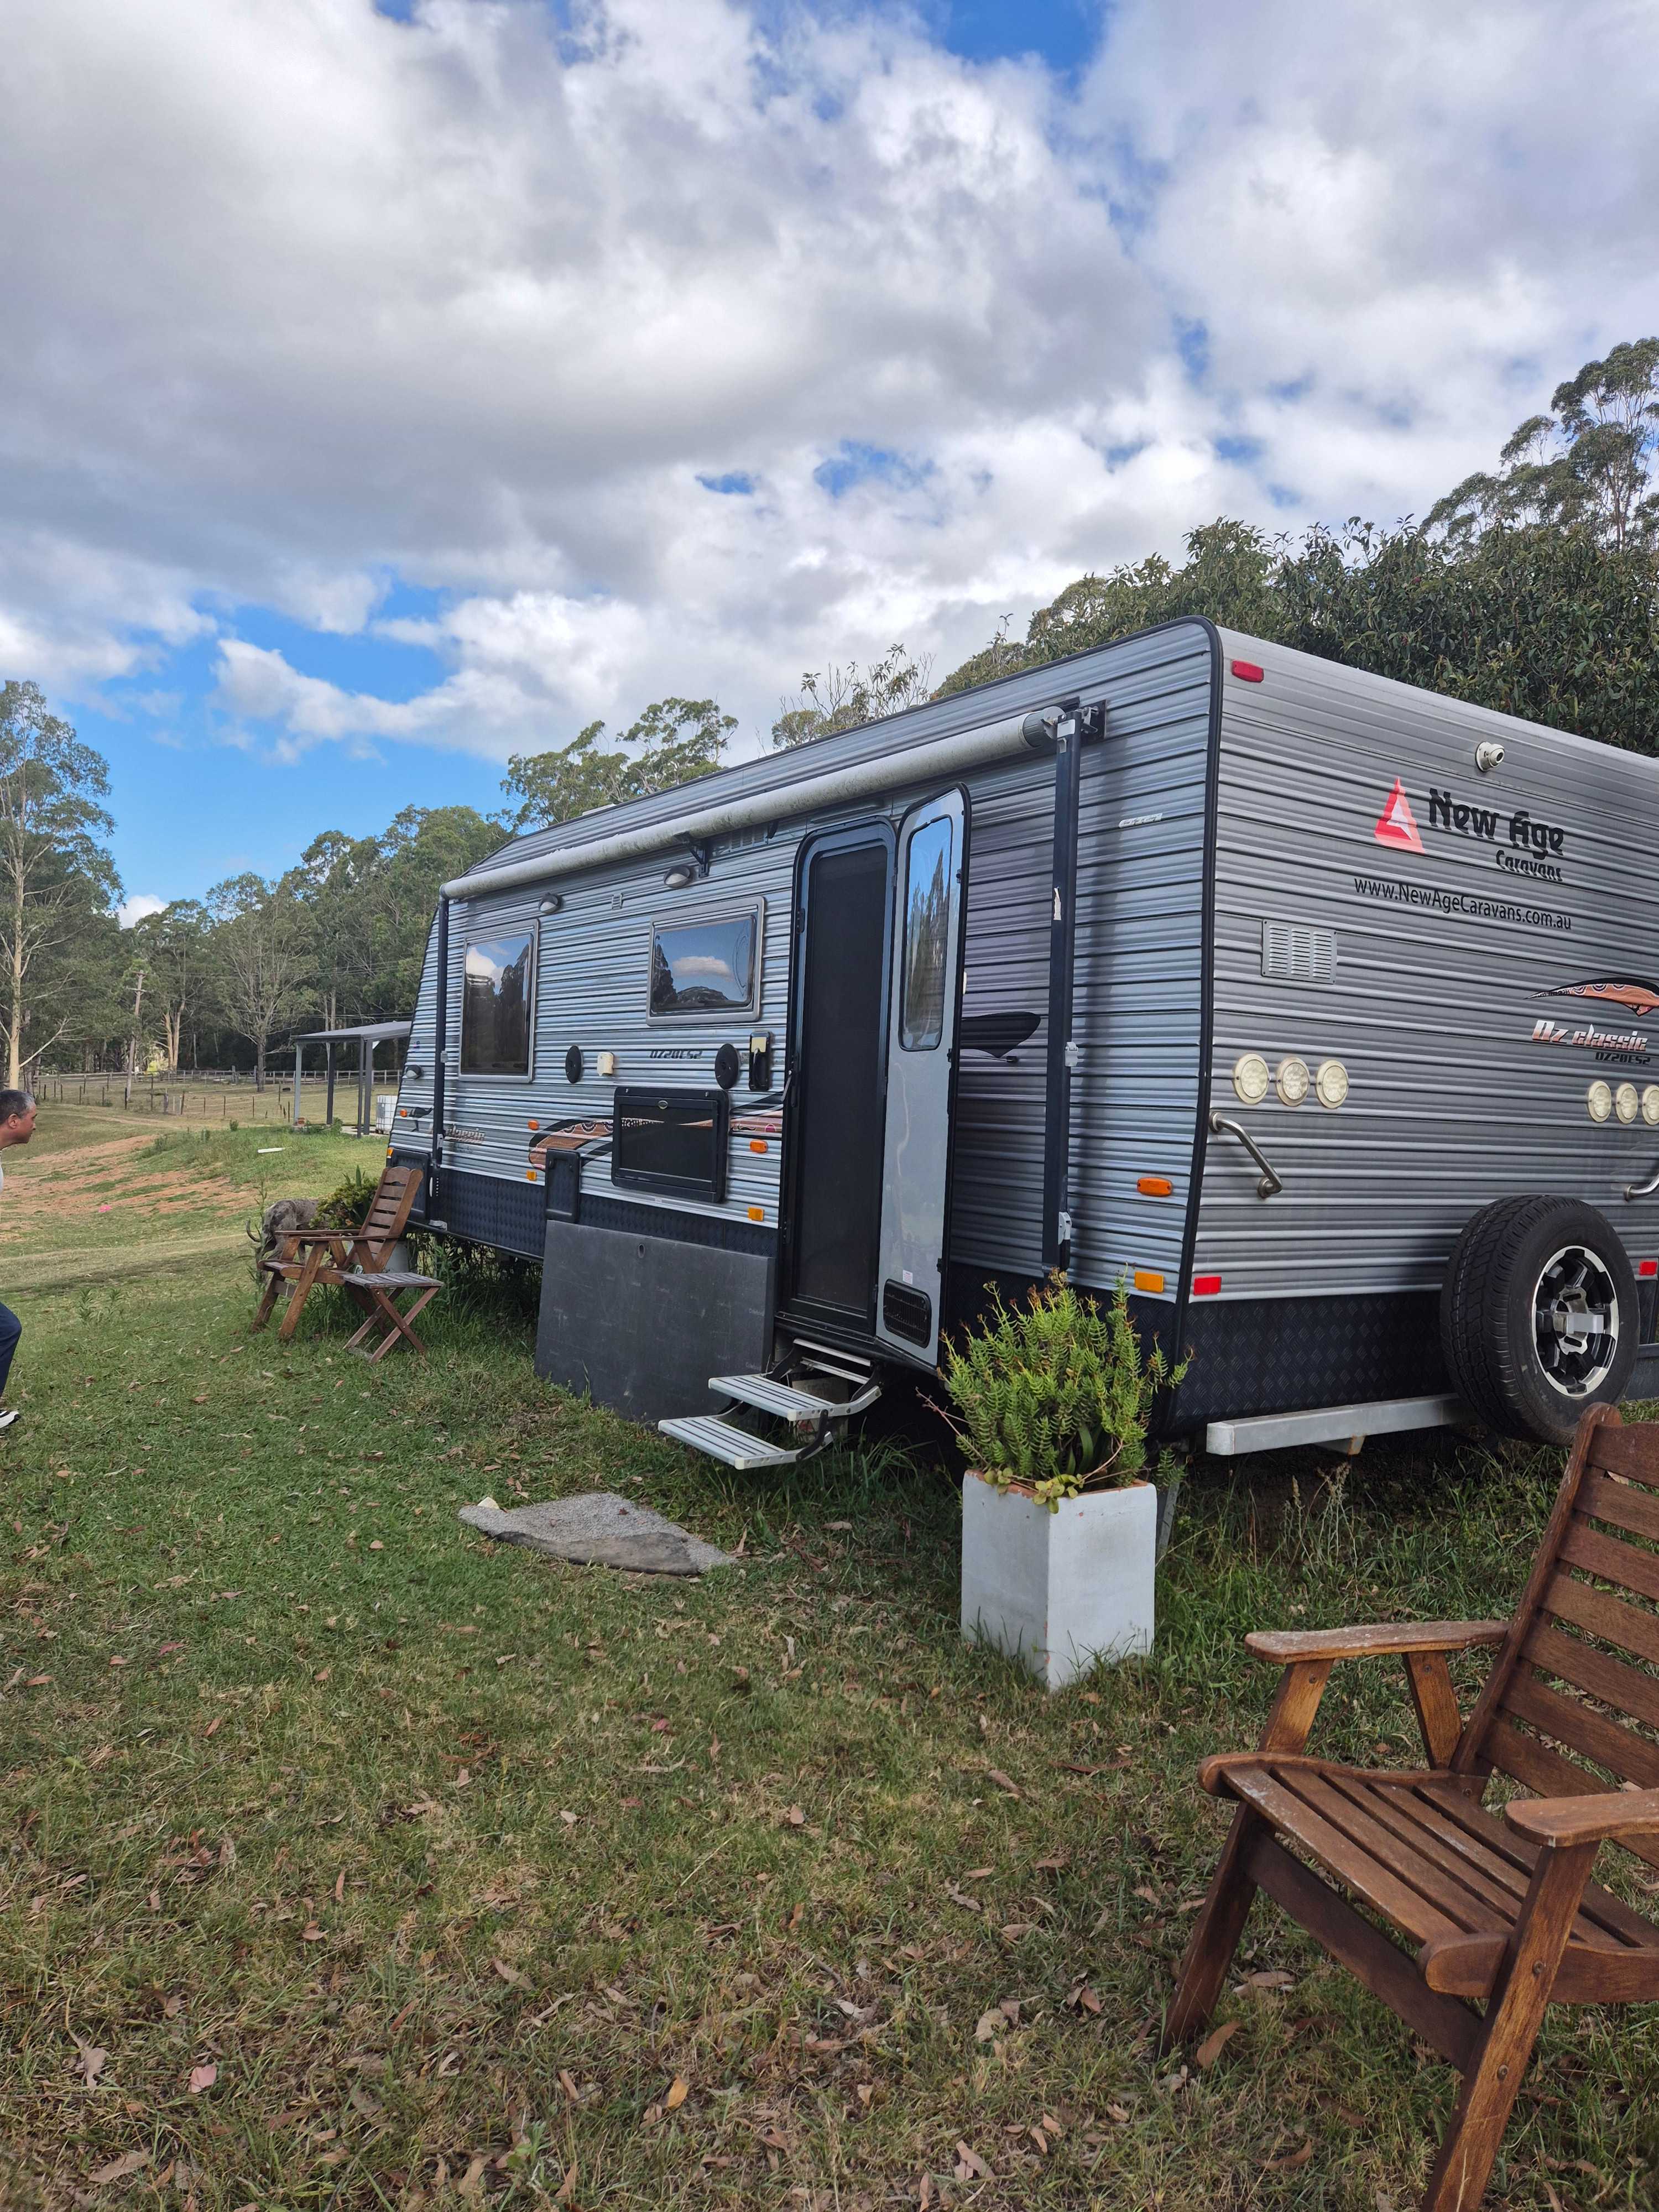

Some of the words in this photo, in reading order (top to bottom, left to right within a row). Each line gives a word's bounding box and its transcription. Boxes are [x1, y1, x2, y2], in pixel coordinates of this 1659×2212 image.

[1429, 787, 1500, 840] New
[1509, 811, 1566, 860] Age
[1495, 849, 1563, 881] Caravans
[1353, 878, 1572, 930] www.NewAgeCaravans.com.au
[1532, 1020, 1569, 1044] Oz
[1572, 1024, 1648, 1052] classic
